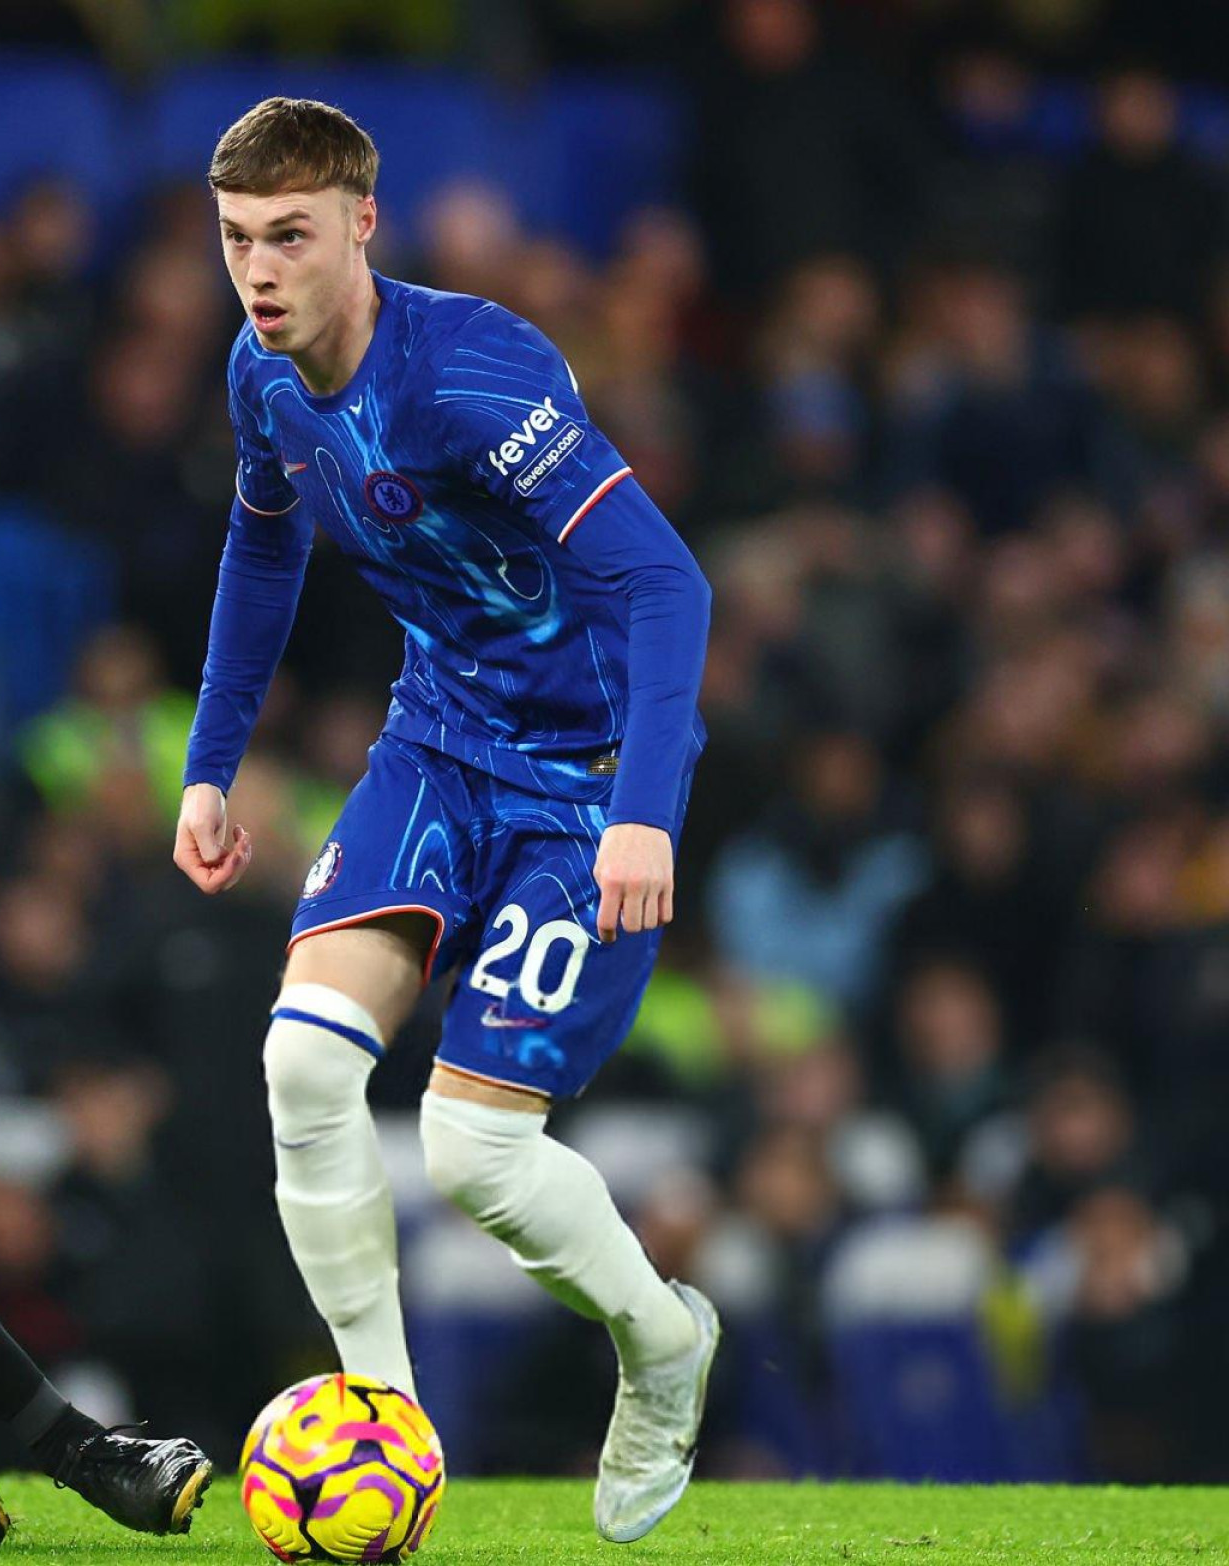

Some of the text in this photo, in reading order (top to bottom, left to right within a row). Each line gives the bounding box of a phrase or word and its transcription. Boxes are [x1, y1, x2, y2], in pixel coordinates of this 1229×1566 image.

[489, 396, 560, 476] fever
[517, 428, 580, 490] feverup.com
[470, 903, 590, 1014] 20
